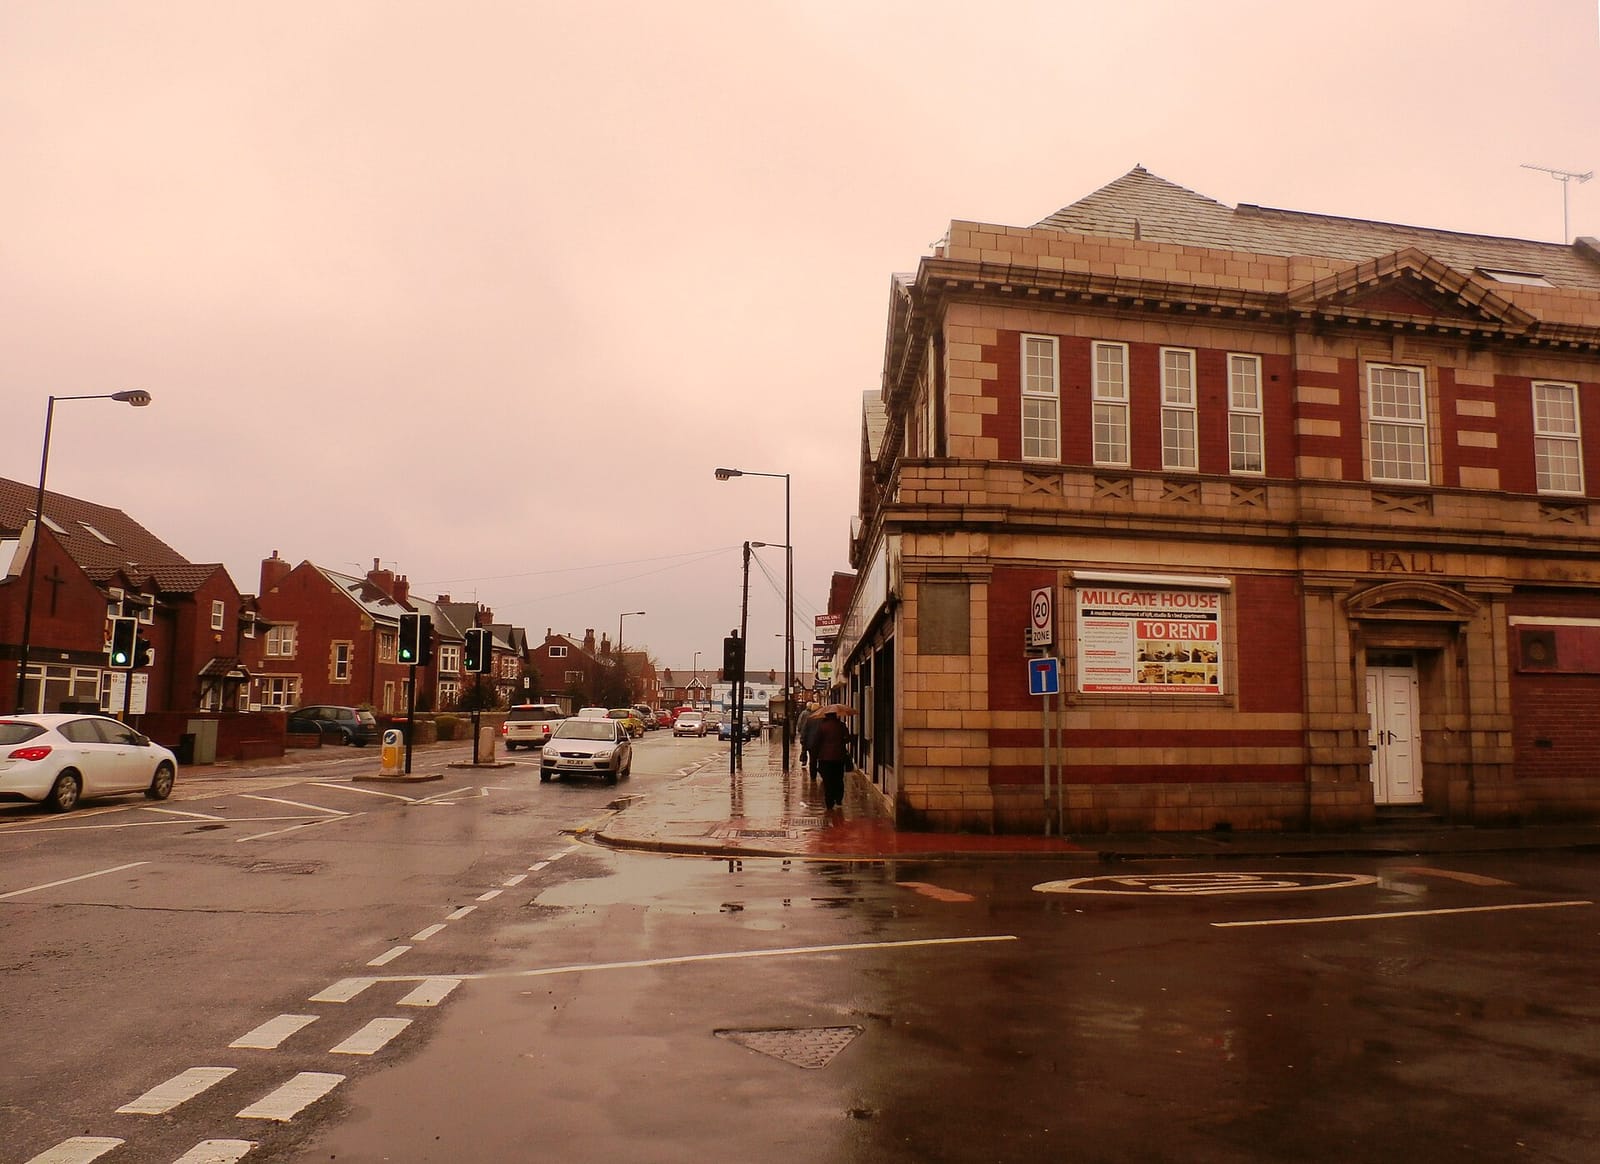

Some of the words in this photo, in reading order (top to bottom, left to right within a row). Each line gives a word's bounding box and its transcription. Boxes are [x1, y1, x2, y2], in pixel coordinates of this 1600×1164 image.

[1369, 551, 1444, 573] HALL
[1082, 590, 1157, 606] MILLGATE
[1161, 594, 1217, 608] HOUSE
[1035, 602, 1047, 618] 20
[1033, 630, 1050, 641] ZONE
[1143, 622, 1165, 638] TO
[1169, 623, 1209, 639] RENT
